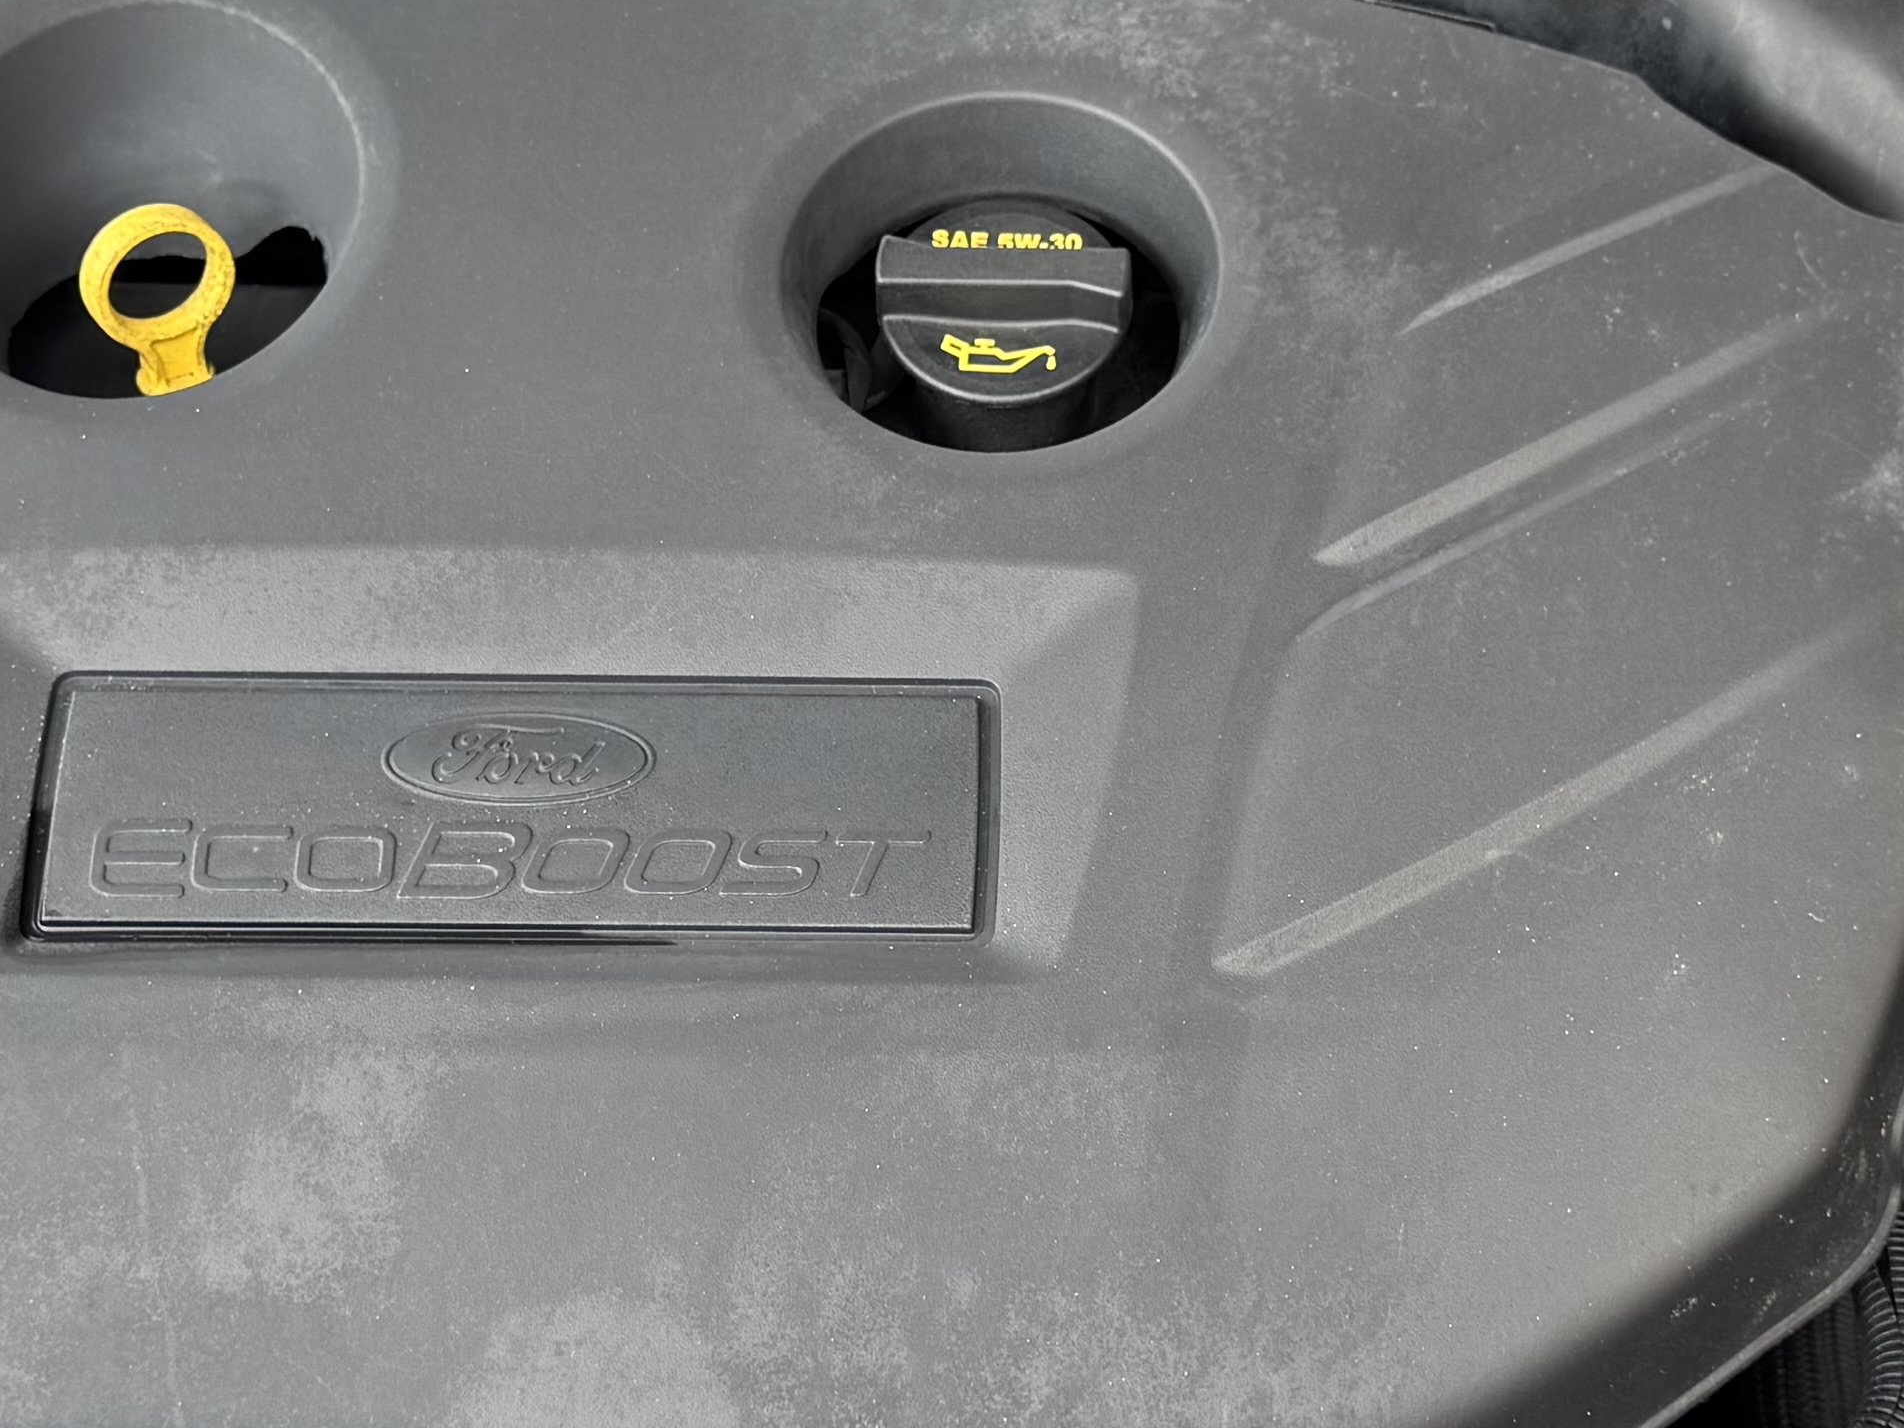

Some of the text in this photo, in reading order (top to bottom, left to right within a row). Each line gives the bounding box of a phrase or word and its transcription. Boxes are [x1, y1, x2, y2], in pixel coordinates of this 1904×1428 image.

[931, 229, 1083, 250] SAE 5W-30
[433, 724, 607, 789] Ford
